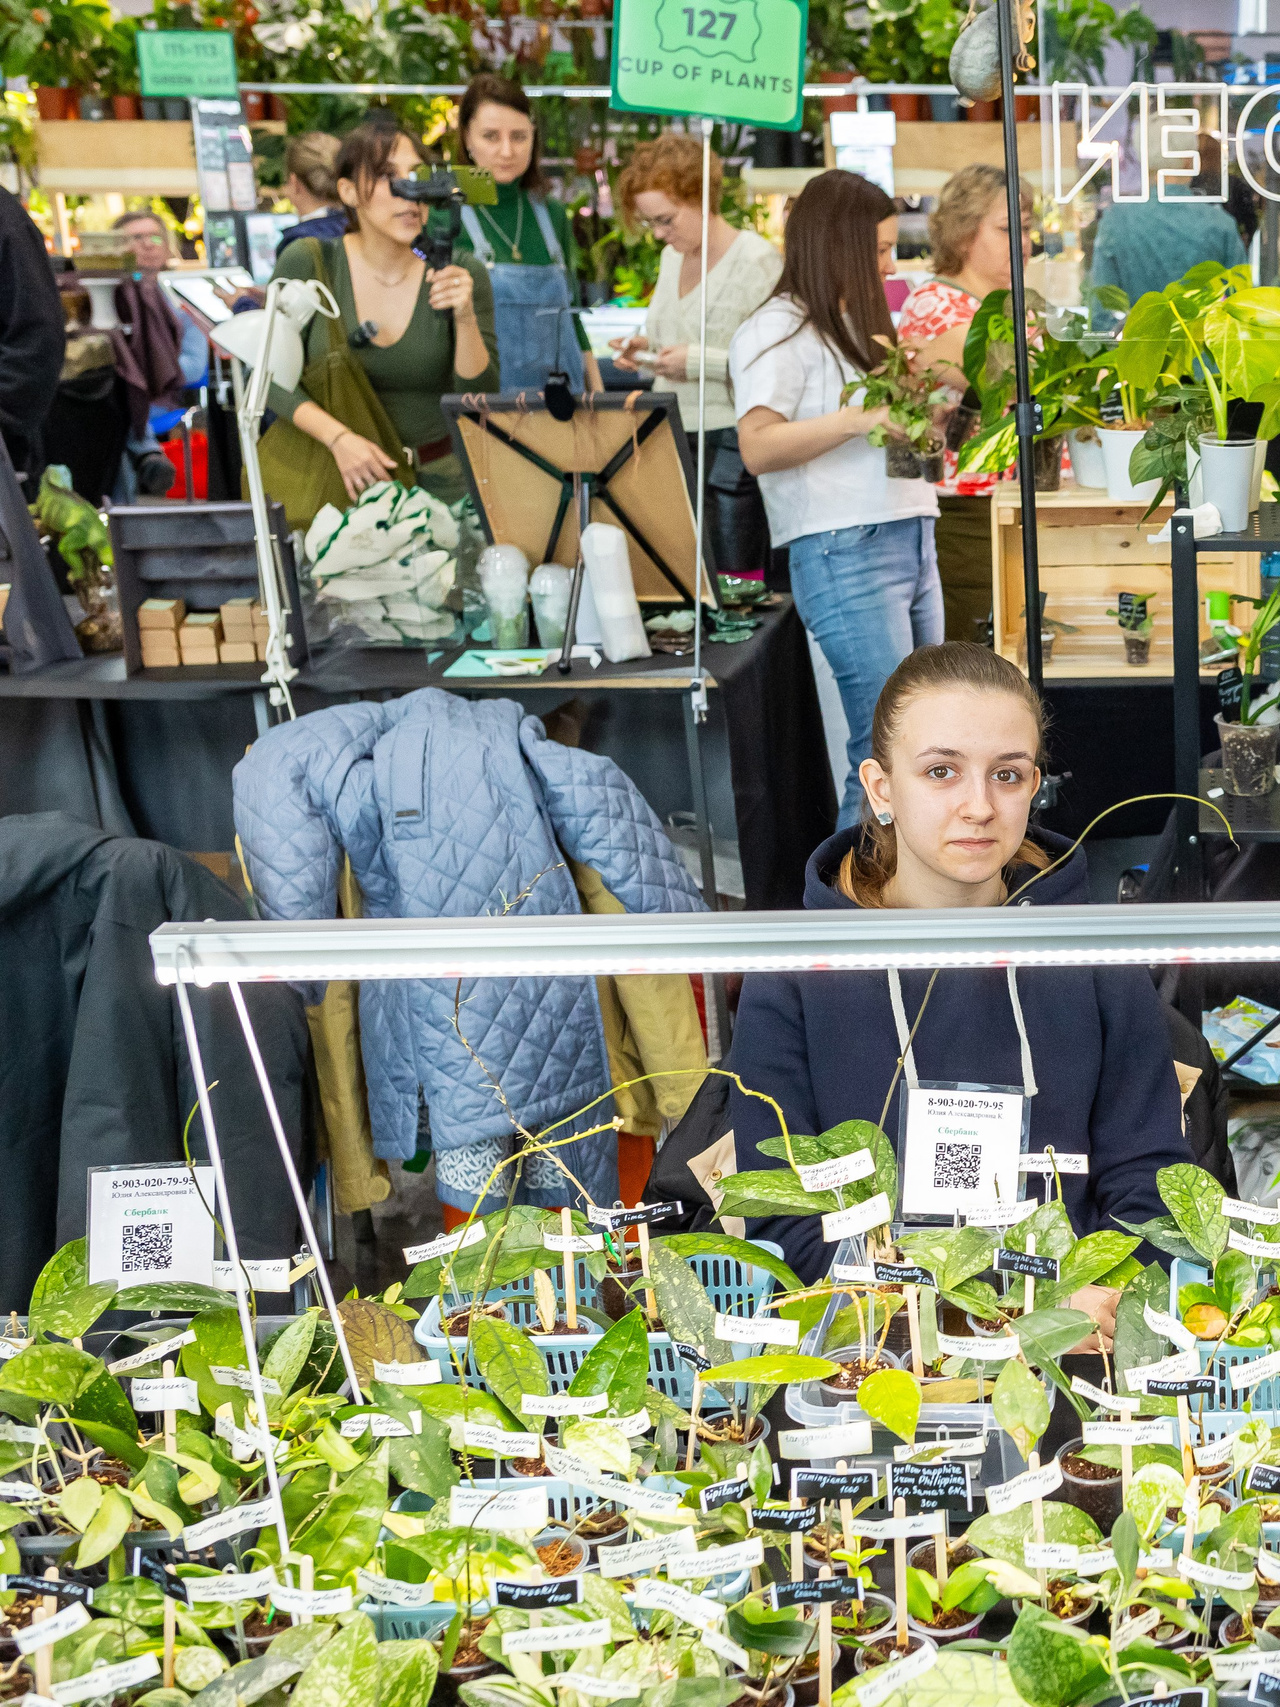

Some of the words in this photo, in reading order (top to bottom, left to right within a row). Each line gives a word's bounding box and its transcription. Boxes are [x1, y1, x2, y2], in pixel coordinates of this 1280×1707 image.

[682, 7, 737, 41] 127
[618, 57, 663, 76] CUP
[673, 64, 701, 81] OF
[711, 68, 793, 94] PLANTS
[928, 1097, 1004, 1111] 8-903-020-79-95
[938, 1126, 979, 1136] Сбербанк
[112, 1176, 196, 1190] 8-903-020-79-95
[111, 1191, 132, 1199] Юлия
[133, 1189, 187, 1198] Александровна
[124, 1208, 168, 1217] Сбербанк
[1149, 1381, 1189, 1390] medusa
[920, 1499, 938, 1508] 300
